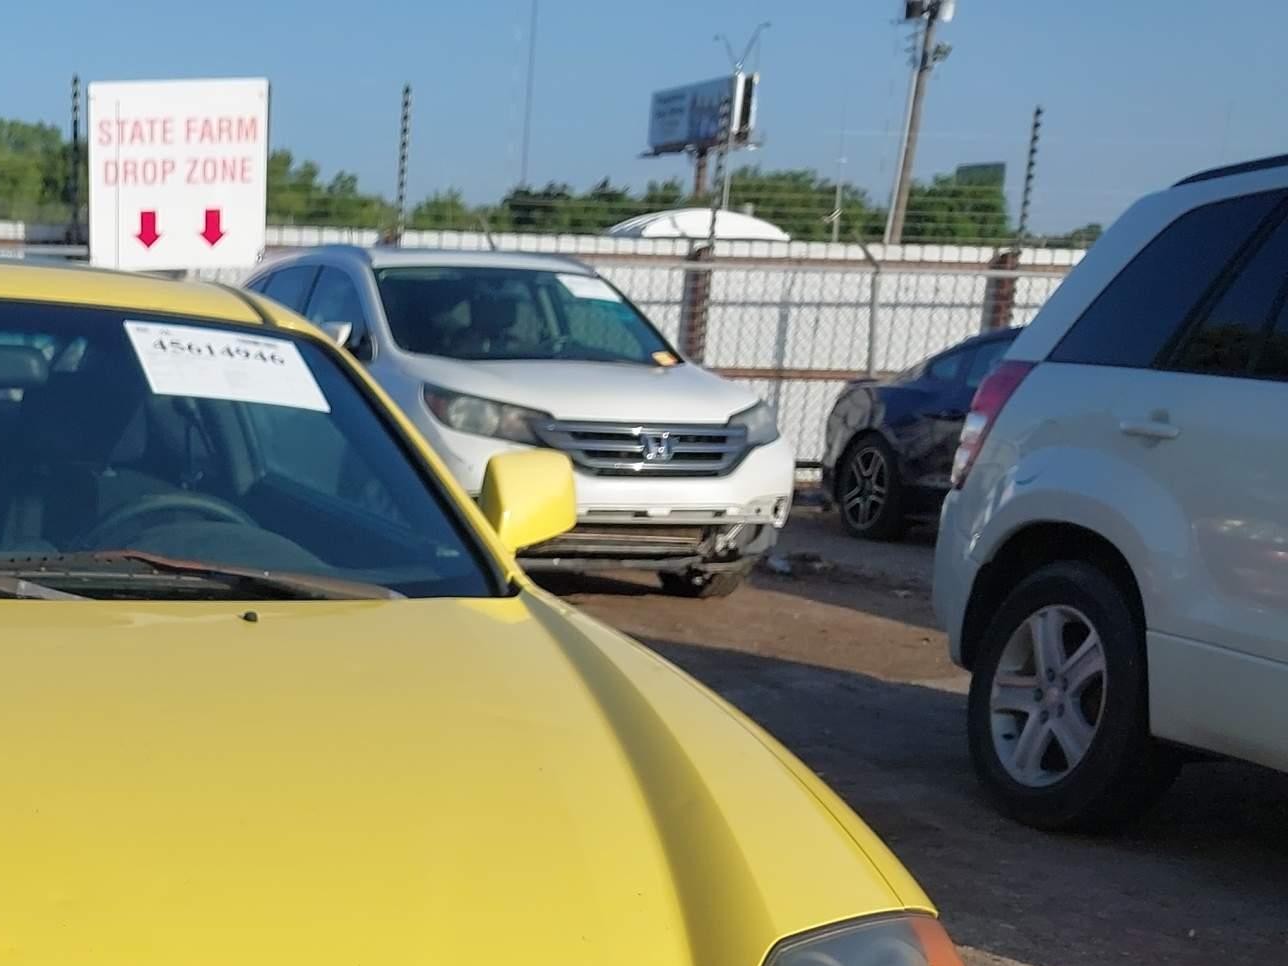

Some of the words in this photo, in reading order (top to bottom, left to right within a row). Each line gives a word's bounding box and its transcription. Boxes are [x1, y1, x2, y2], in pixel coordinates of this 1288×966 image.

[98, 117, 175, 146] STATE
[185, 115, 258, 145] FARM
[103, 158, 176, 186] DROP
[186, 156, 253, 185] ZONE
[153, 337, 285, 366] 45614946
